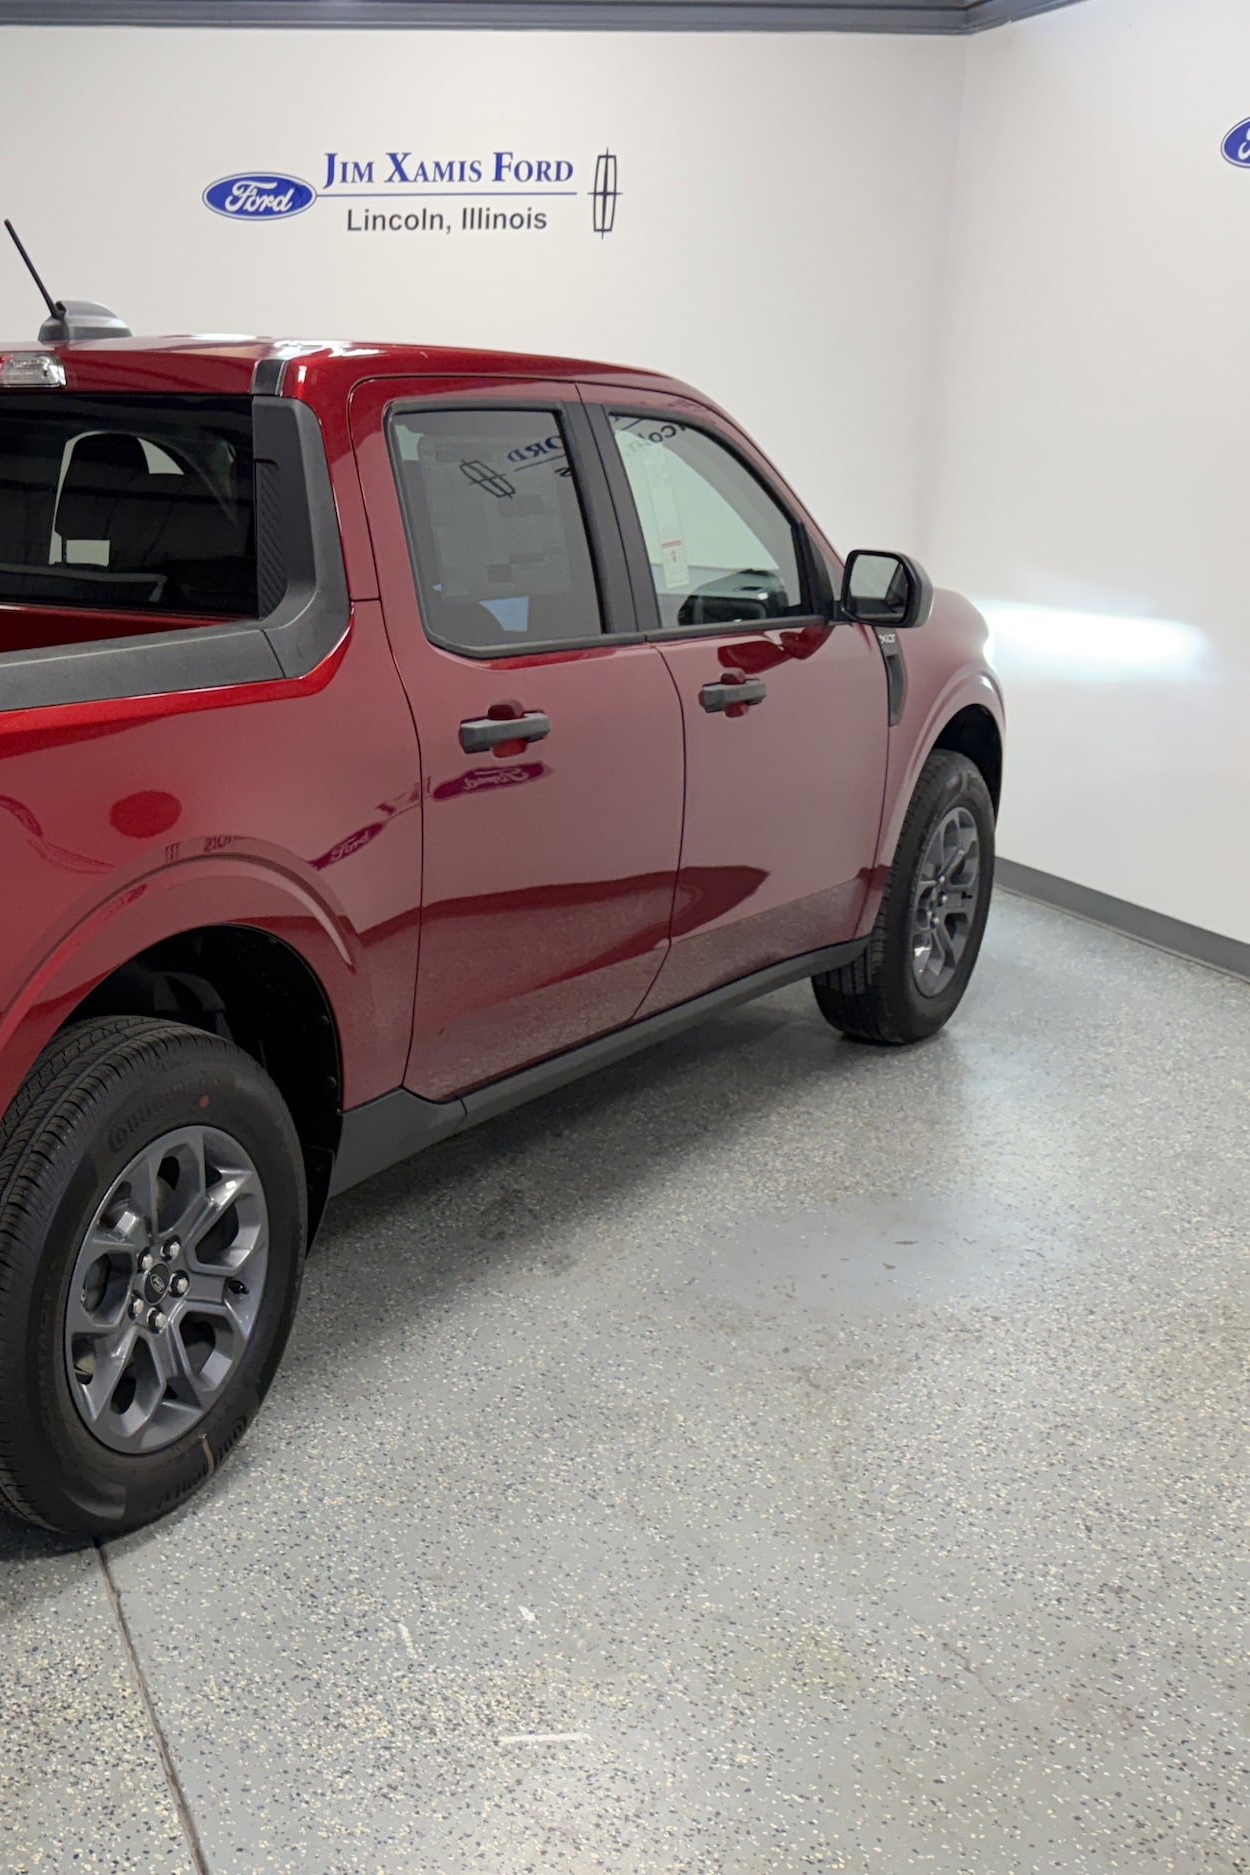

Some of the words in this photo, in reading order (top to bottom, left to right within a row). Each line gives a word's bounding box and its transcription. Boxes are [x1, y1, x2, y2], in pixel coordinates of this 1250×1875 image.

[225, 180, 293, 213] Ford
[347, 208, 452, 235] Lincoln,
[462, 207, 547, 231] Illinois
